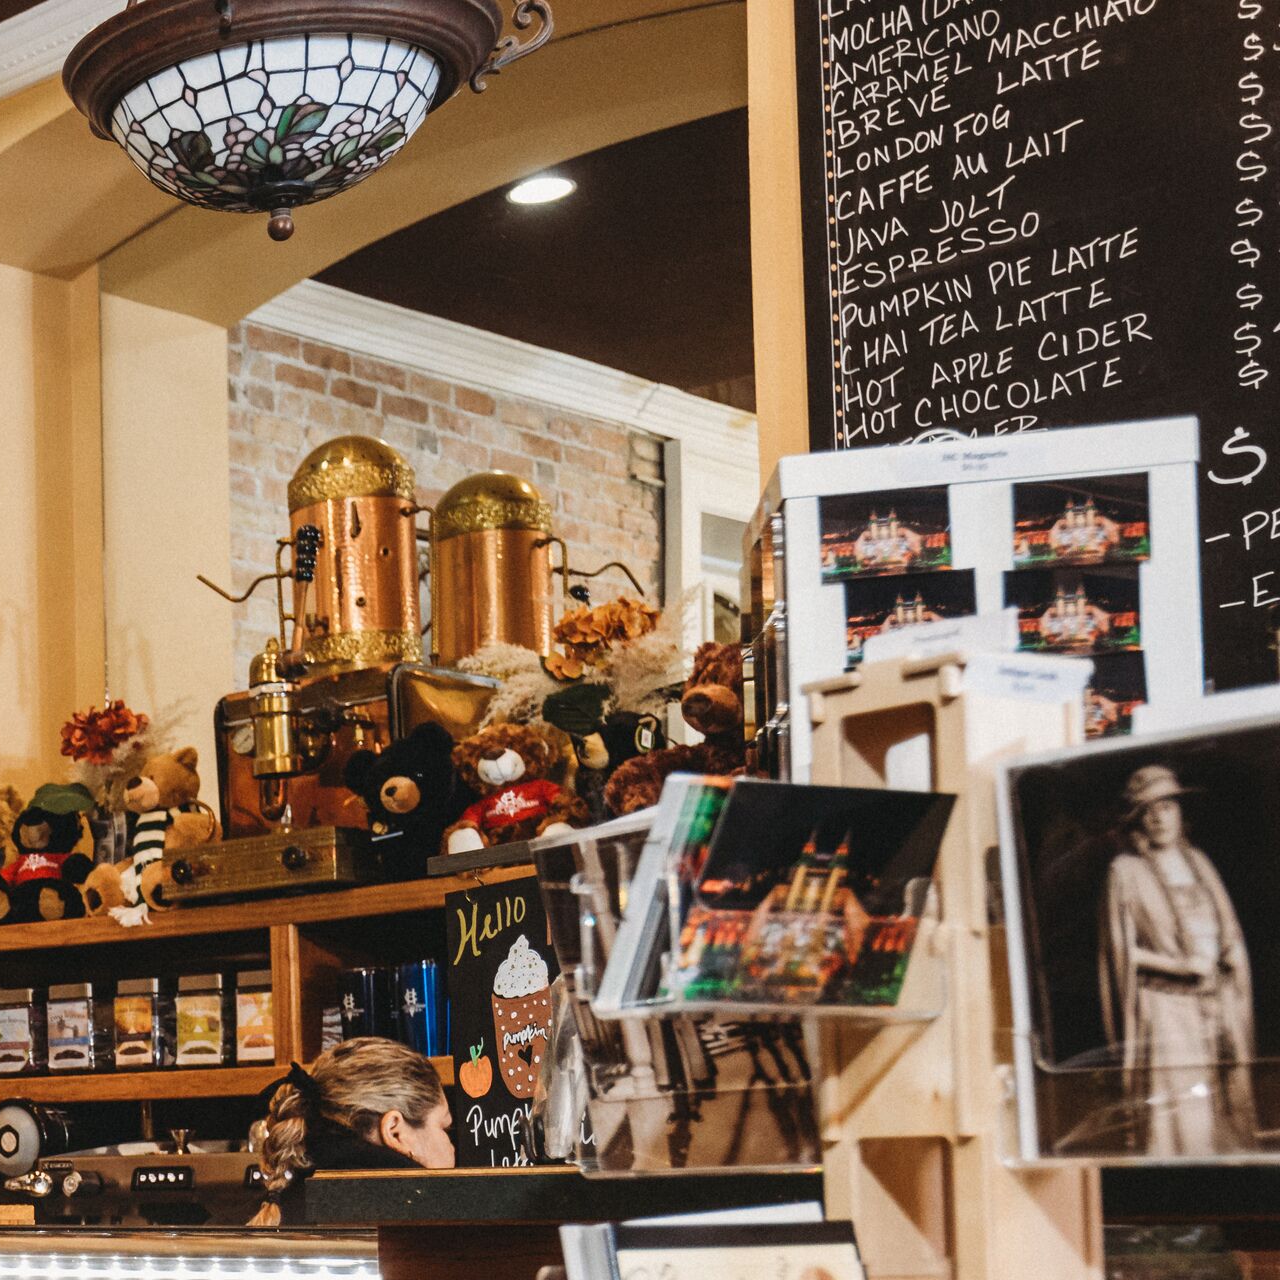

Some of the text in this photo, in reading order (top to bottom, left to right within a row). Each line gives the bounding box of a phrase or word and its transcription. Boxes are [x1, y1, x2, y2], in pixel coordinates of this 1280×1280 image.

[830, 4, 913, 61] MOCHA
[831, 10, 1000, 90] AMERICANO
[831, 0, 1157, 117] CARAMEL MACCHIATO
[997, 40, 1102, 95] LATTE
[835, 104, 1010, 178] LONDON FOG
[836, 119, 1084, 222] CAFFE AU LAIT
[836, 175, 1016, 266] JAVA JOLT
[842, 212, 1040, 294] ESPRESSO
[841, 227, 1138, 338] PUMPKIN PIE LATTE
[841, 278, 1112, 376] CHAI TEA LATTE
[843, 312, 1153, 412] HOT APPLE CIDER
[844, 403, 902, 448] HOT
[914, 356, 1123, 428] CHOCOLATE
[453, 896, 527, 966] Hello
[502, 1022, 549, 1051] pumpkin
